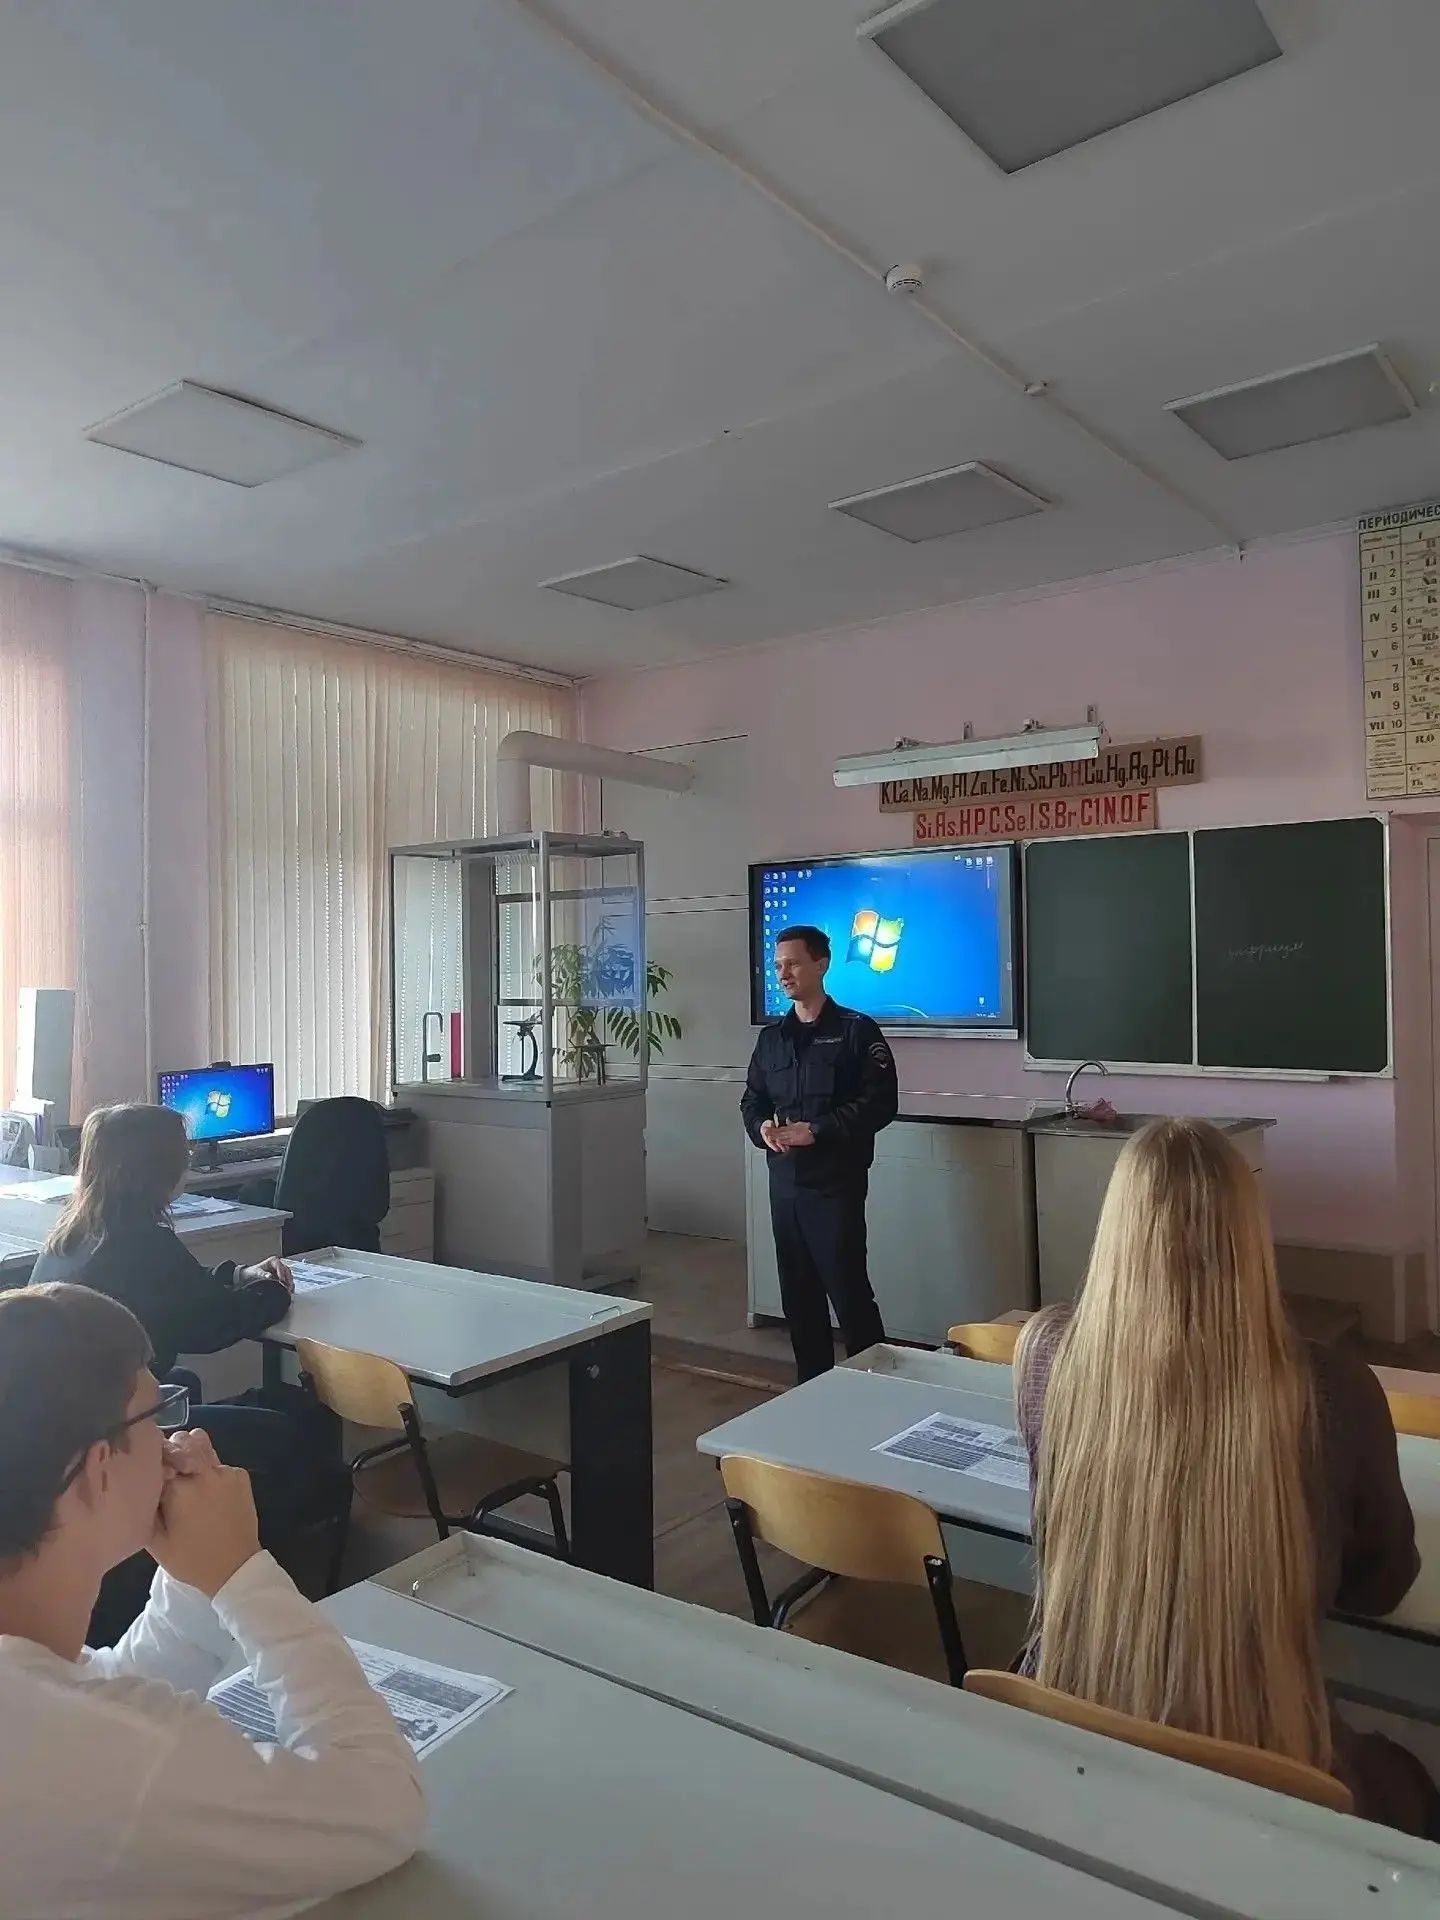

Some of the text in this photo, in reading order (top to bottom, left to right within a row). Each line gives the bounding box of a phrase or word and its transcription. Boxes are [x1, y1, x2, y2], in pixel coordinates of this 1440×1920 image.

[1389, 568, 1397, 578] 2
[1389, 587, 1397, 596] 3
[1390, 605, 1397, 614] 4
[1391, 623, 1398, 632] 5
[1391, 641, 1398, 651] 6
[1391, 664, 1399, 673] 7
[1392, 683, 1400, 692] 8
[1392, 701, 1400, 710] 9
[1391, 719, 1402, 729] 10
